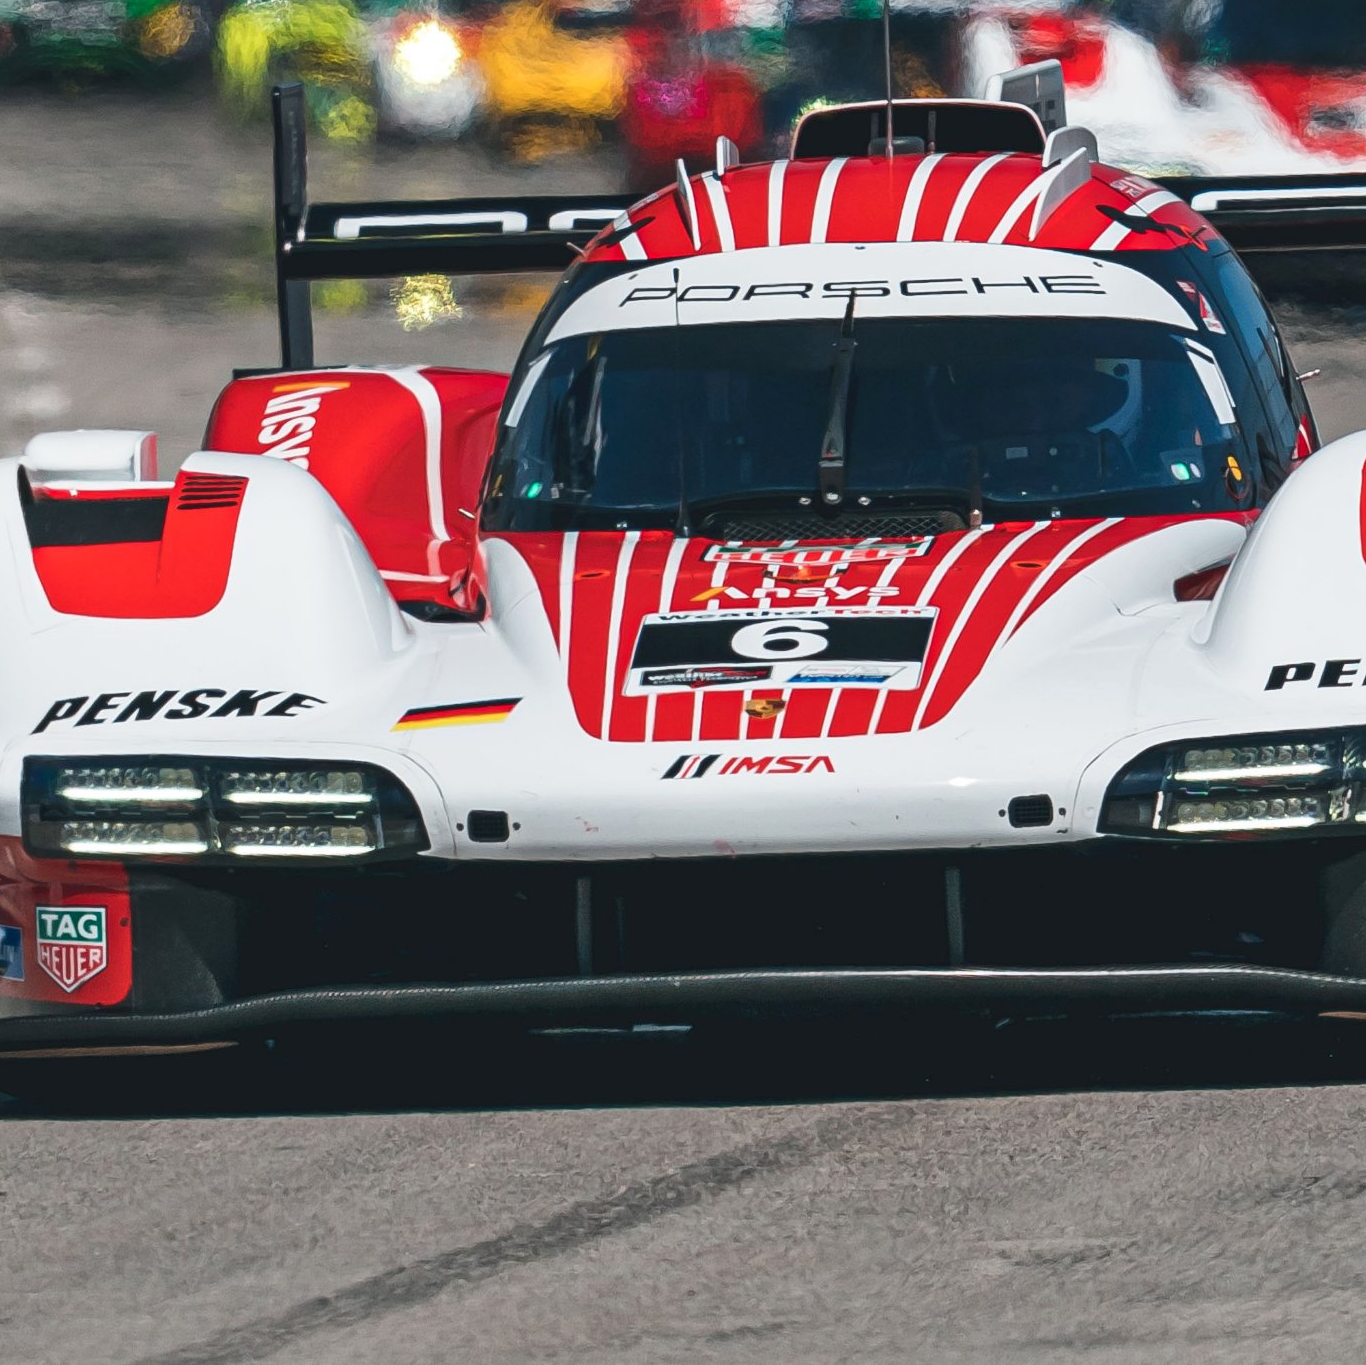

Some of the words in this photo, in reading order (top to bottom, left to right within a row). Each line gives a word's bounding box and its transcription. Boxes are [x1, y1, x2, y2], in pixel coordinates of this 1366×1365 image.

[619, 275, 1107, 308] PORSCHE
[731, 620, 830, 659] 6
[29, 689, 329, 735] PENSKE
[718, 756, 836, 775] IMSA
[41, 913, 99, 939] TAG
[41, 944, 102, 985] HEUER
